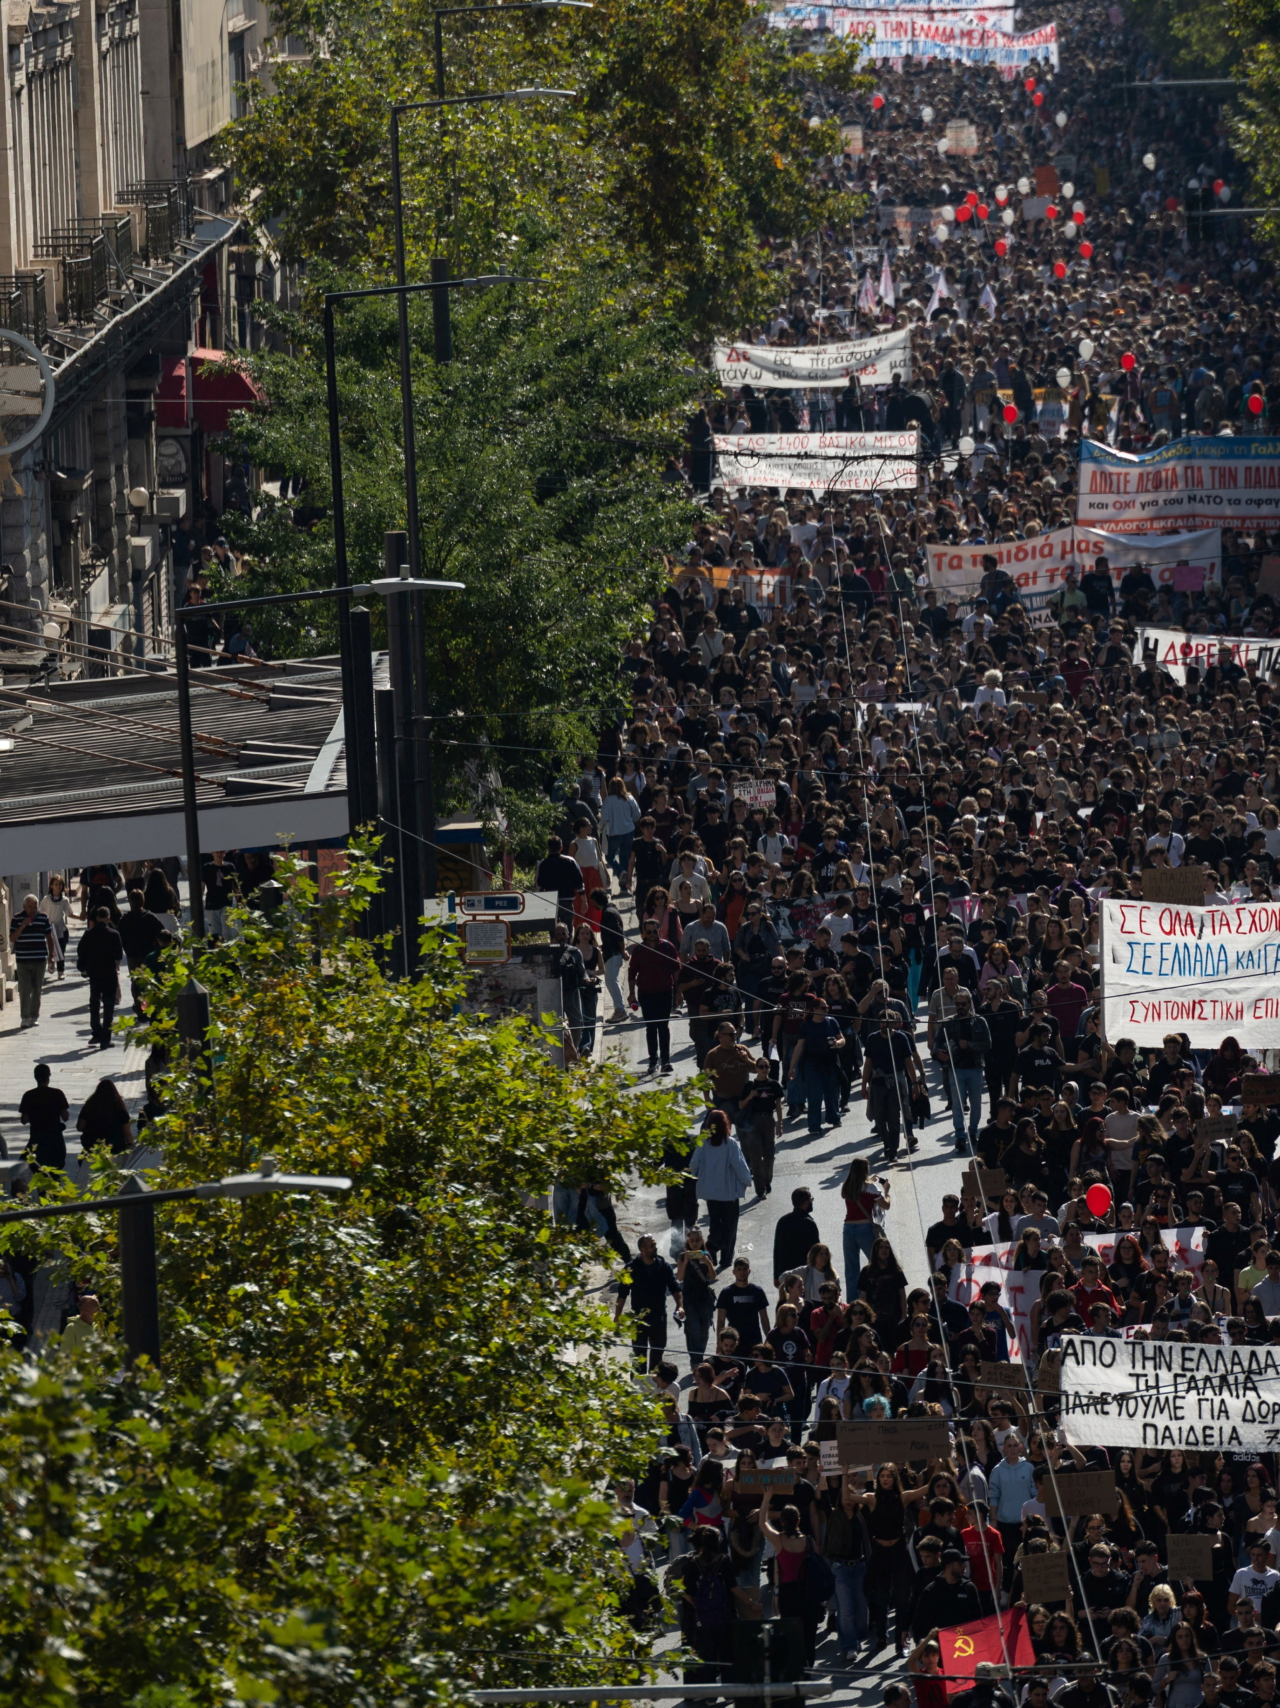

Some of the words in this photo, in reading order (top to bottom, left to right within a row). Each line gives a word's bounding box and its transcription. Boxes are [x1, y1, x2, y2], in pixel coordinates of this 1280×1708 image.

[882, 20, 908, 39] ΤΗΝ
[912, 20, 955, 44] ΕΛΛΑΔΑ
[726, 347, 750, 363] Δε
[773, 353, 792, 366] θα
[809, 347, 882, 370] περάσουν
[819, 435, 865, 449] ΒΑΣΙΚΟ
[873, 435, 917, 448] ΜΙΣΘΟ
[1196, 443, 1230, 457] μέχρι
[1233, 446, 1249, 456] τη
[1089, 469, 1131, 494] ΔΩΣΤΕ
[1136, 467, 1179, 494] ΛΕΦΤΑ
[1184, 467, 1205, 489] ΓΙΑ
[1209, 466, 1239, 489] ΤΗΝ
[1088, 500, 1109, 511] και
[1112, 499, 1136, 510] ΟΧΙ
[1139, 500, 1159, 512] για
[1163, 496, 1184, 508] του
[1187, 494, 1224, 506] ΝΑΤΟ
[1227, 497, 1242, 507] τα
[1095, 521, 1151, 532] ΣΥΛΛΟΓΟΙ
[1153, 518, 1241, 529] ΕΚΠΑΙΔΕΥΤΙΚΩΝ
[932, 552, 964, 572] Τα
[1060, 538, 1105, 559] μας
[1011, 569, 1038, 588] αι
[1158, 561, 1217, 584] σς!
[1163, 640, 1250, 669] ΔΩΡΕΝ
[1160, 871, 1201, 885] ΠΑΙΔΕΙΑ
[1119, 904, 1150, 936] ΣΕ
[1158, 907, 1197, 938] ΟΛΑ
[1205, 909, 1232, 937] ΤΑ
[1126, 941, 1157, 976] ΣΕ
[1158, 942, 1229, 978] ΕΛΛΑΔΑ
[1234, 949, 1262, 972] ΚΑΙ
[1127, 998, 1245, 1024] ΣΥΝΤΟΝΙΣΤΙΚΗ
[1034, 1058, 1052, 1067] FILA
[1061, 1338, 1117, 1369] ΑΠΟ
[1124, 1341, 1173, 1373] ΤΗΝ
[1181, 1345, 1280, 1376] ΕΛΛΑΔΑ
[1128, 1371, 1161, 1395] ΤΗ
[1172, 1372, 1262, 1399] ΓΑΛΛΙΑ
[1060, 1389, 1185, 1422] ΠΑΛΕΥΟΥΜΕ
[1198, 1397, 1230, 1421] ΓΙΑ
[1142, 1423, 1243, 1448] ΠΑΙΔΕΙΑ
[1061, 1498, 1102, 1510] URVIVRE?
